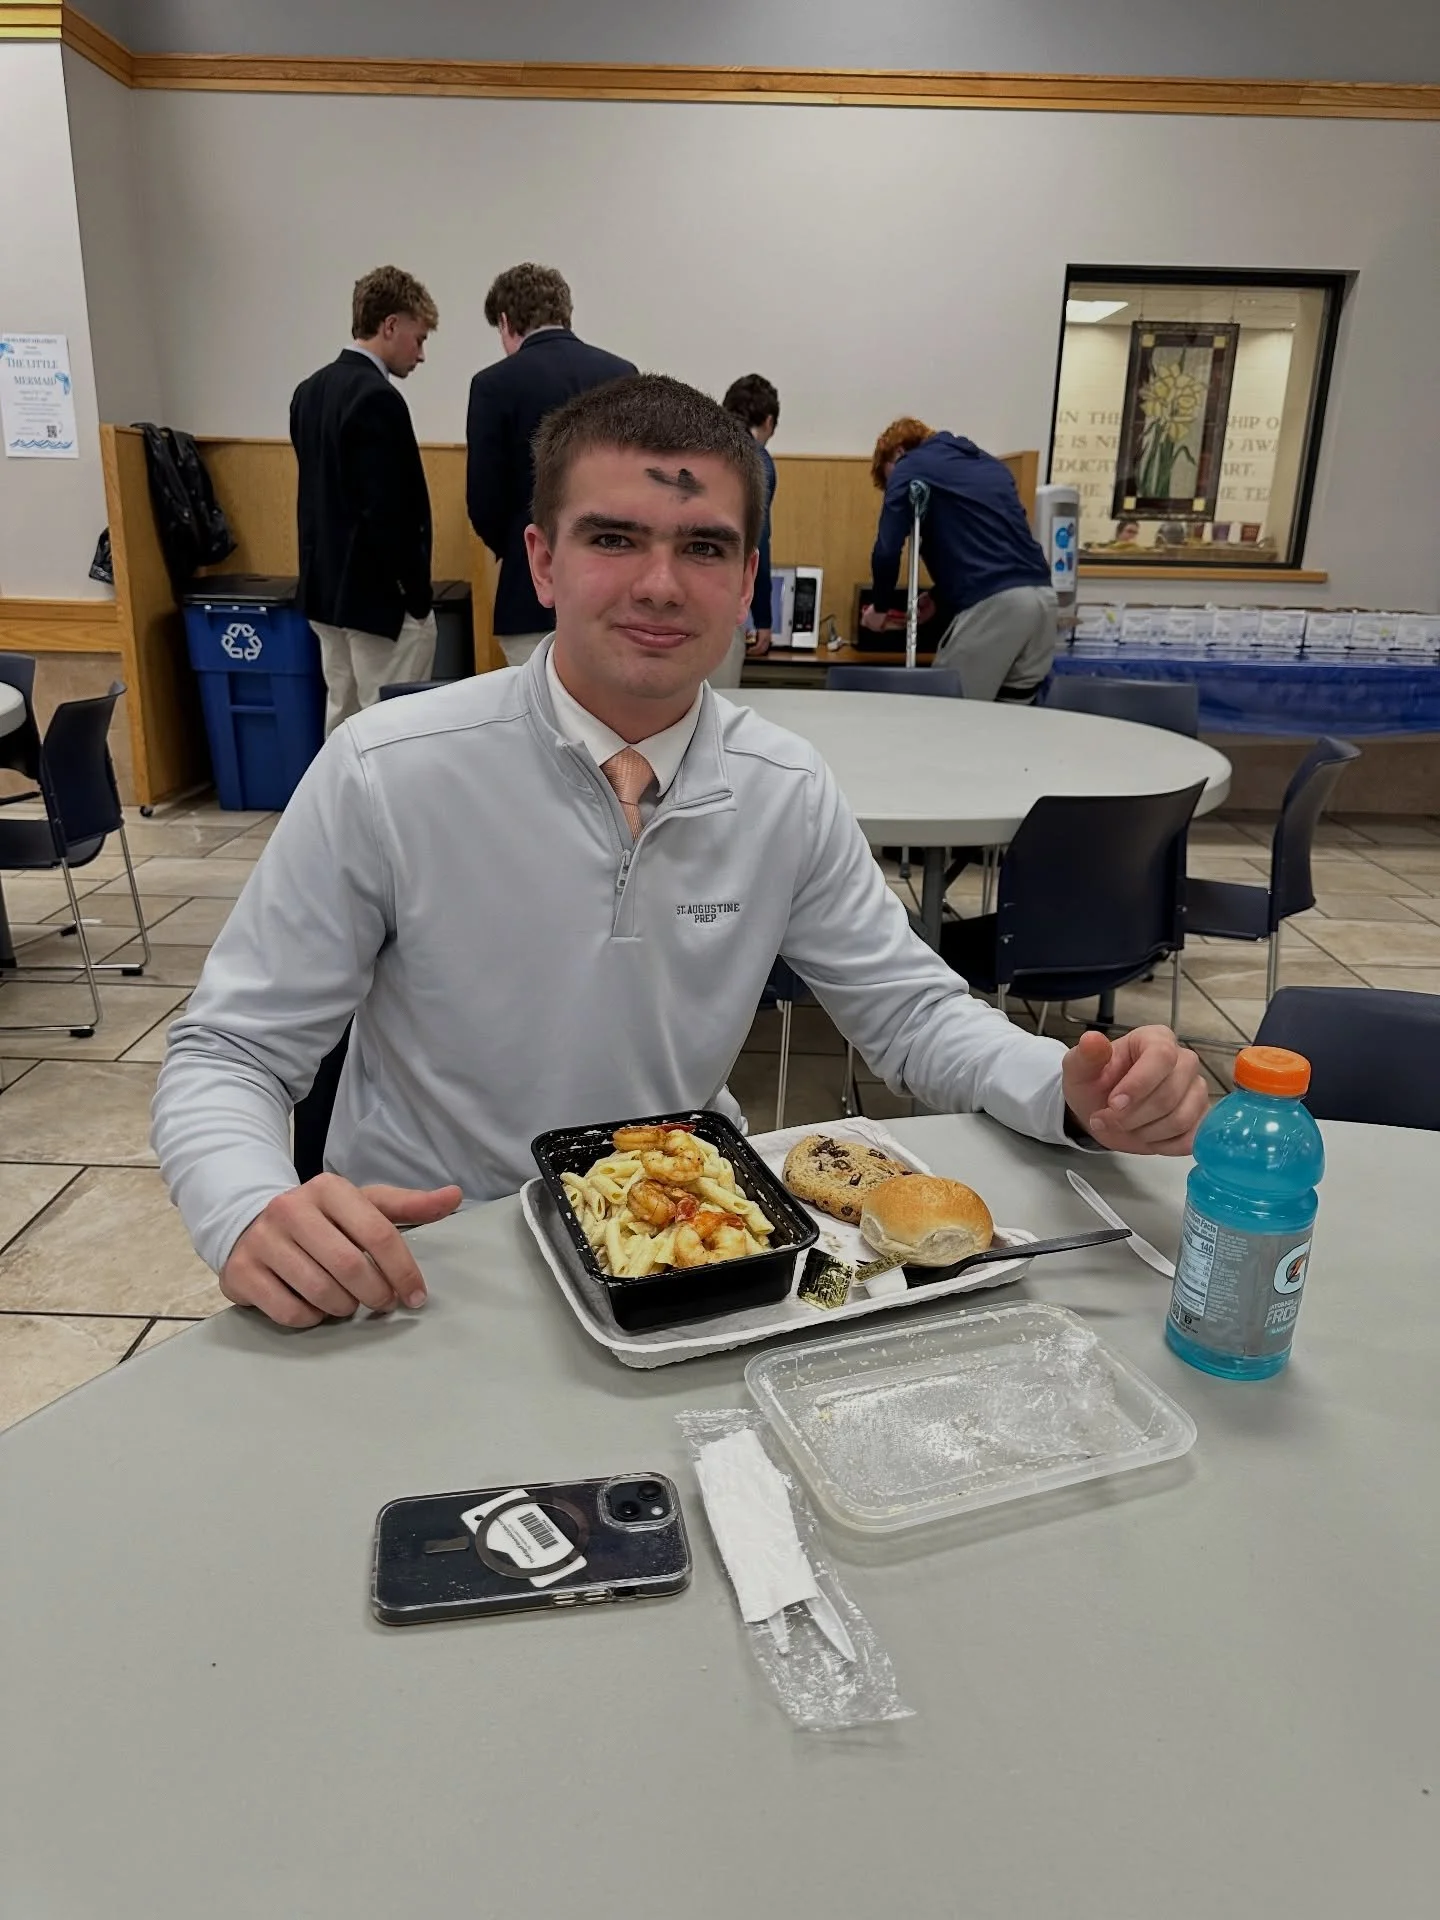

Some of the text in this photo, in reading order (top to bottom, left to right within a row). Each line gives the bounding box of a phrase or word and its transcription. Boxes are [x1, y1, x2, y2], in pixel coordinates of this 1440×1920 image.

[7, 358, 58, 369] THE LITTLE
[1227, 415, 1260, 429] HIP
[687, 903, 740, 914] AUGUSTINE
[694, 913, 717, 923] PREP
[1200, 1218, 1217, 1233] Facts
[1200, 1241, 1214, 1254] 140
[1264, 1305, 1296, 1328] FROS
